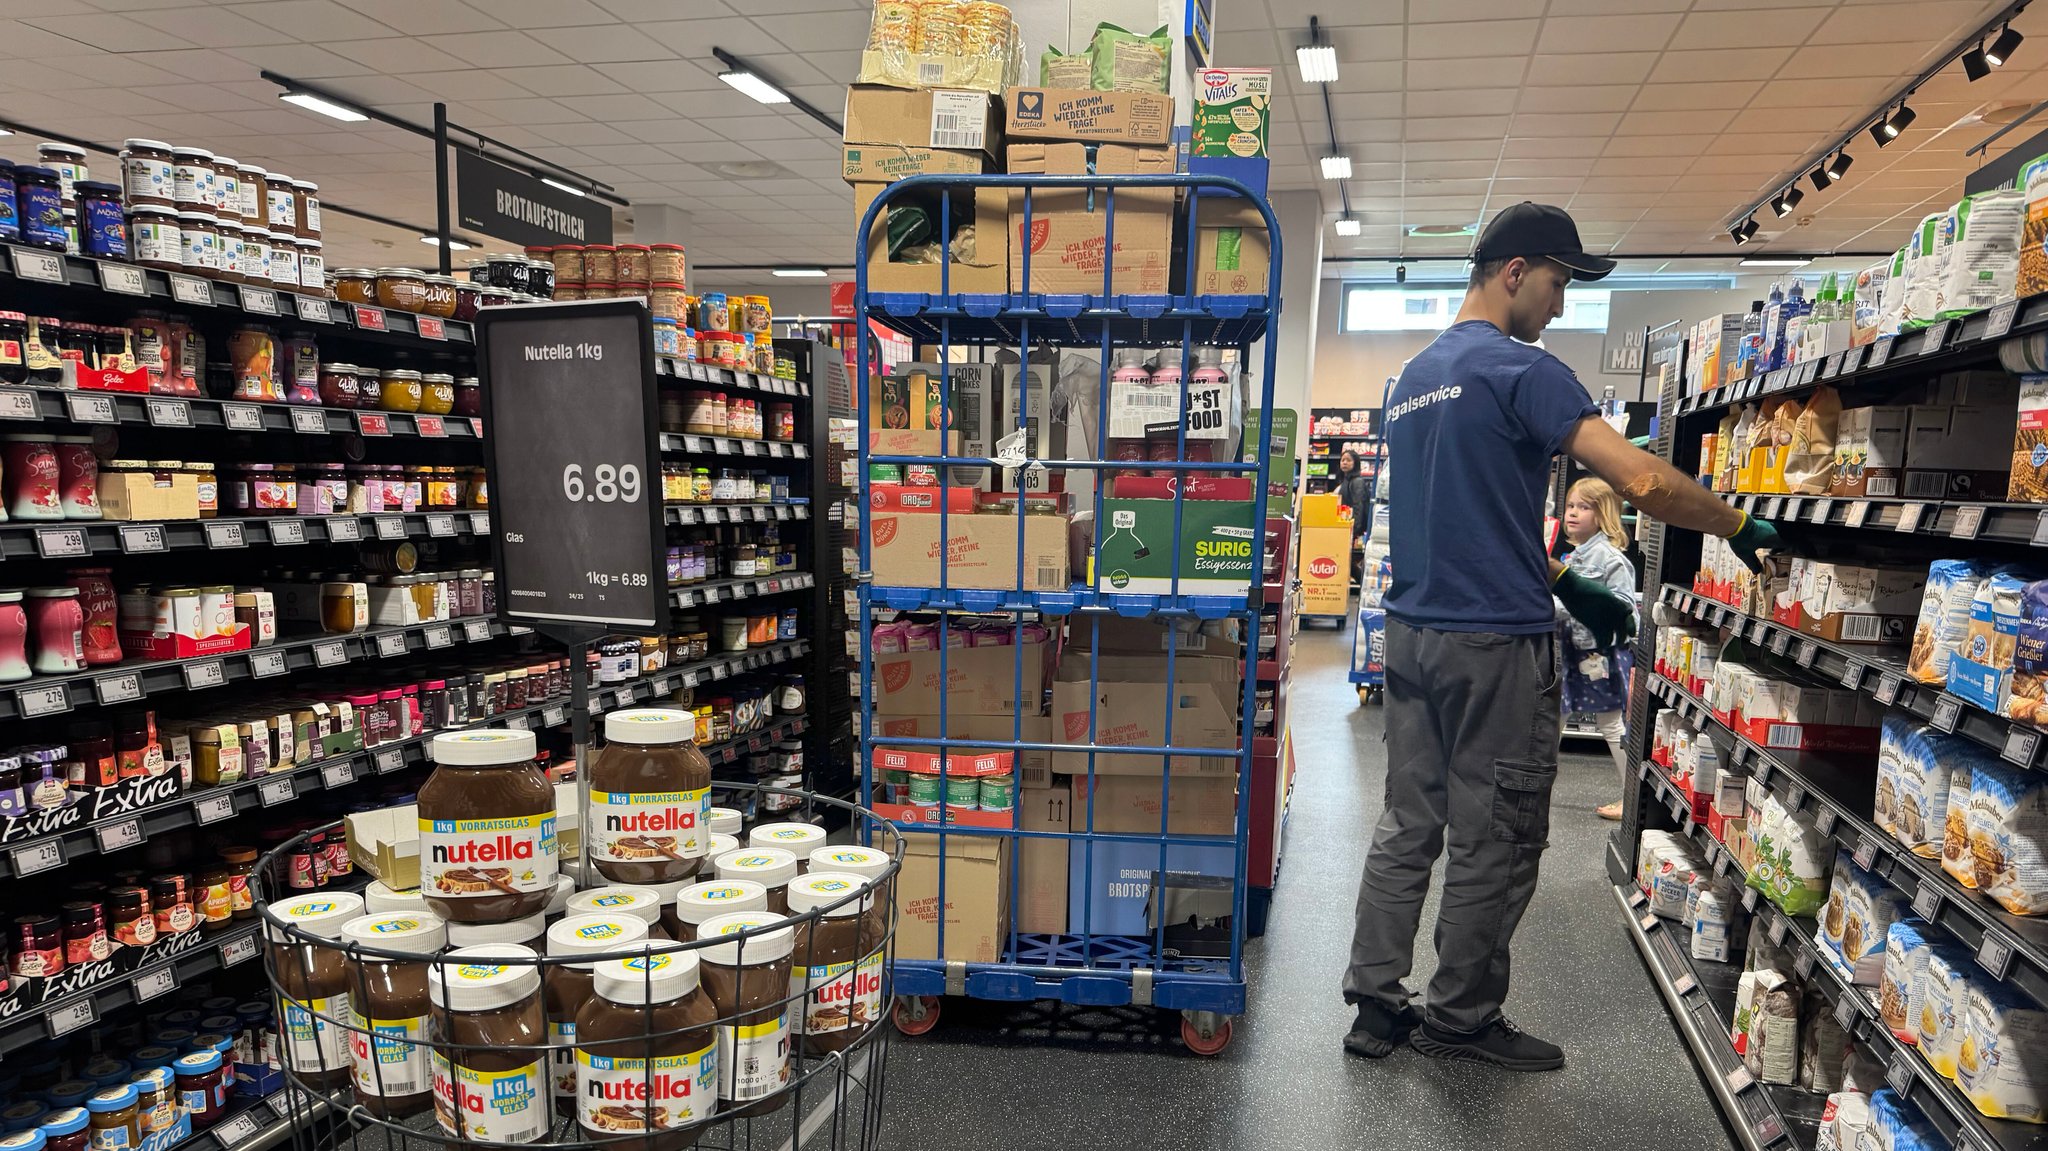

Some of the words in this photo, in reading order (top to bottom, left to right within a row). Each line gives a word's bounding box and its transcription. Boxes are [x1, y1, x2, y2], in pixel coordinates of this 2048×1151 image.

[1248, 81, 1267, 89] MÜSLI
[1059, 102, 1073, 112] ICH
[1076, 96, 1103, 109] KOMM
[1090, 104, 1115, 117] KEINE
[1011, 120, 1046, 129] Herzstücke
[1069, 118, 1098, 129] FRAGE!
[875, 160, 886, 168] ICH
[887, 157, 906, 167] KOMM
[883, 165, 901, 173] KEINE
[903, 162, 923, 172] FRAGE!
[845, 166, 862, 176] Bio
[496, 189, 585, 241] BROTAUFSTRICH
[1066, 242, 1080, 253] ICH
[41, 260, 58, 272] 2.99
[125, 270, 140, 285] 3.29
[194, 282, 208, 296] 4.19
[425, 285, 452, 302] GLÜCK
[524, 343, 573, 361] Nutella
[576, 342, 602, 360] 1kg
[103, 374, 124, 387] Gelee
[955, 368, 981, 381] CORN
[15, 397, 31, 408] 2.99
[95, 401, 110, 413] 2.59
[1386, 384, 1462, 422] egalservice
[1186, 409, 1222, 431] FOOD
[72, 453, 96, 477] Sam
[563, 463, 641, 502] 6.89
[1166, 477, 1199, 500] Smt
[902, 495, 917, 506] ORO
[1115, 519, 1134, 527] Original
[227, 529, 240, 539] 2.59
[289, 525, 300, 535] 2.59
[65, 534, 81, 546] 2.99
[145, 531, 160, 543] 2.59
[506, 532, 524, 544] Glas
[947, 536, 969, 547] KOMM
[958, 543, 980, 553] KEINE
[1195, 541, 1251, 557] SURIG
[1195, 557, 1253, 574] Essigessenz
[1307, 562, 1338, 576] Autan
[586, 571, 608, 587] 1kg
[622, 572, 647, 587] 6.89
[2020, 633, 2045, 650] Wiener
[2018, 647, 2043, 662] Grießler
[269, 656, 283, 667] 2.99
[206, 666, 220, 677] 2.99
[121, 679, 137, 691] 4.29
[45, 691, 63, 703] 2.79
[1127, 730, 1149, 740] KEINE
[886, 755, 905, 766] FELIX
[932, 759, 951, 770] FEX
[976, 759, 995, 770] FELIX
[279, 782, 291, 794] 2.99
[93, 774, 177, 819] Extra
[612, 794, 627, 806] 1kg
[634, 792, 693, 804] VORRATSGLAS
[216, 798, 230, 811] 2.99
[1969, 800, 2004, 822] Mehlzauber
[2, 804, 80, 843] Extra
[436, 820, 453, 833] 1kg
[461, 818, 529, 831] VORRATSGLAS
[606, 808, 695, 832] nutella
[121, 825, 137, 837] 4.29
[39, 846, 57, 860] 2.79
[433, 836, 533, 863] nutella
[1109, 883, 1149, 898] BROTSP
[909, 900, 920, 908] ICH
[172, 913, 191, 924] Extra
[918, 912, 938, 921] FRAGE
[138, 926, 154, 936] Extra
[137, 930, 201, 969] Extra
[21, 961, 43, 971] Extra
[811, 967, 825, 977] 1kg
[42, 961, 115, 1001] Extra
[156, 971, 171, 986] 2.79
[74, 1004, 90, 1019] 2.99
[289, 1007, 311, 1024] 1kg
[295, 1032, 314, 1041] GLAS
[382, 1053, 405, 1063] GLAS
[593, 1057, 610, 1069] 1kg
[618, 1056, 689, 1069] VORRTSGLAS
[495, 1077, 525, 1097] 1kg
[588, 1074, 691, 1101] nutella
[737, 1077, 754, 1085] 1000
[433, 1071, 484, 1113] utella
[502, 1101, 526, 1116] GLAS
[235, 1117, 251, 1131] 2.79
